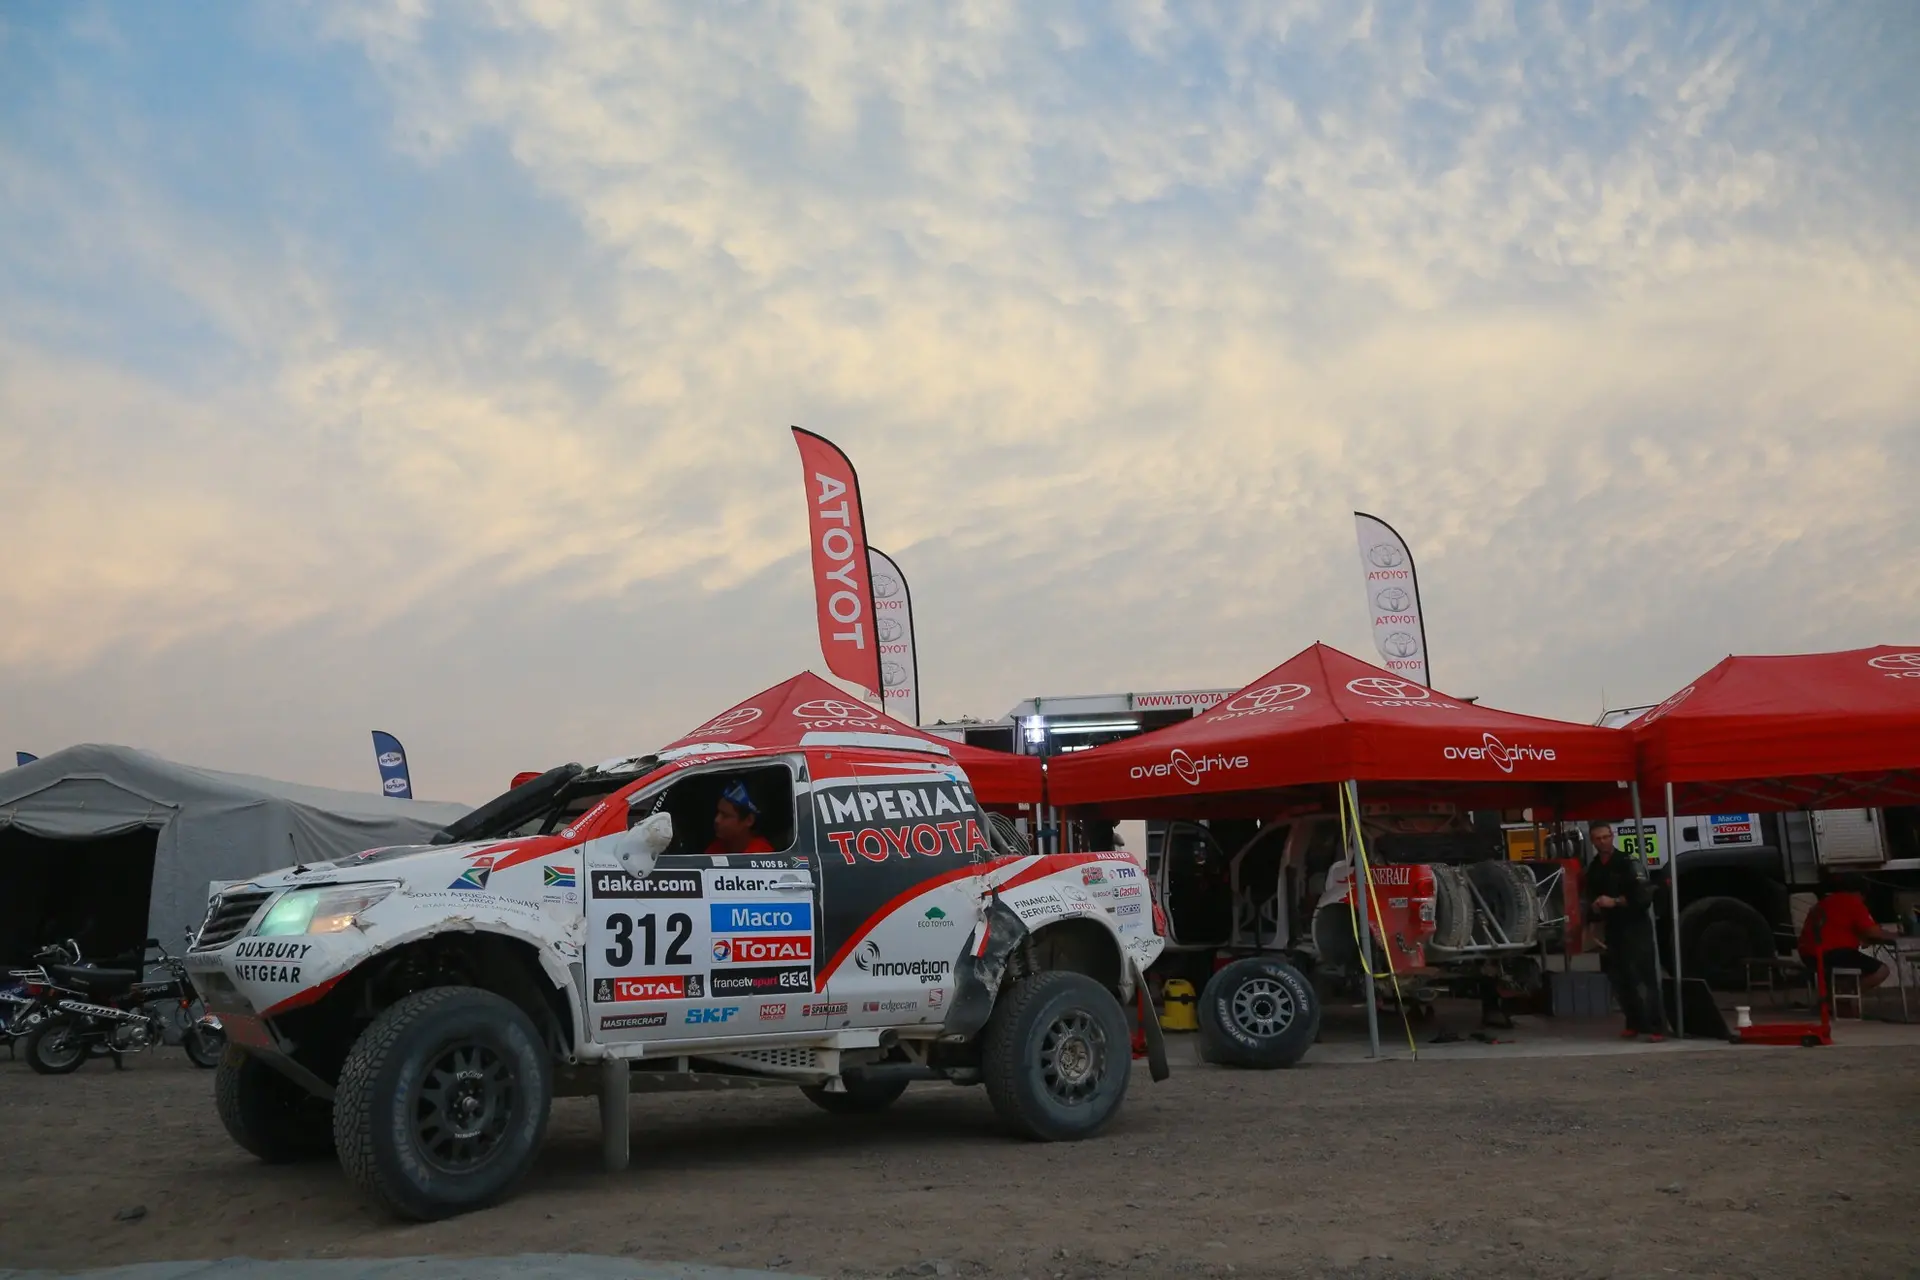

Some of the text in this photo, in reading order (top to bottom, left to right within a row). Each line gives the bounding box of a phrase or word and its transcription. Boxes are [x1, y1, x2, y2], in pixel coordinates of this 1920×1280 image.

[1137, 693, 1236, 706] WWW.TOYOTA
[1206, 705, 1294, 723] TOYOTA
[800, 719, 897, 732] TOYOTA
[817, 785, 976, 824] IMPERIAL
[828, 819, 989, 865] TOYOTA
[760, 860, 776, 868] VOS
[1116, 868, 1136, 878] TFM
[1365, 868, 1411, 885] NERALI
[598, 876, 696, 892] dakar.com
[1014, 894, 1060, 909] FINANCIAL
[731, 909, 792, 927] Macro
[1021, 904, 1063, 919] SERVICES
[605, 912, 693, 967] 312
[236, 942, 312, 959] DUXBURY
[736, 941, 809, 958] TOTAL
[235, 964, 301, 983] NETGEAR
[872, 959, 950, 977] innovation
[920, 974, 942, 984] group
[617, 981, 682, 996] TOTAL
[761, 1004, 785, 1015] NGK
[881, 999, 917, 1013] edgecam
[603, 1016, 665, 1028] MASTERCRAFT
[684, 1006, 740, 1024] SKF
